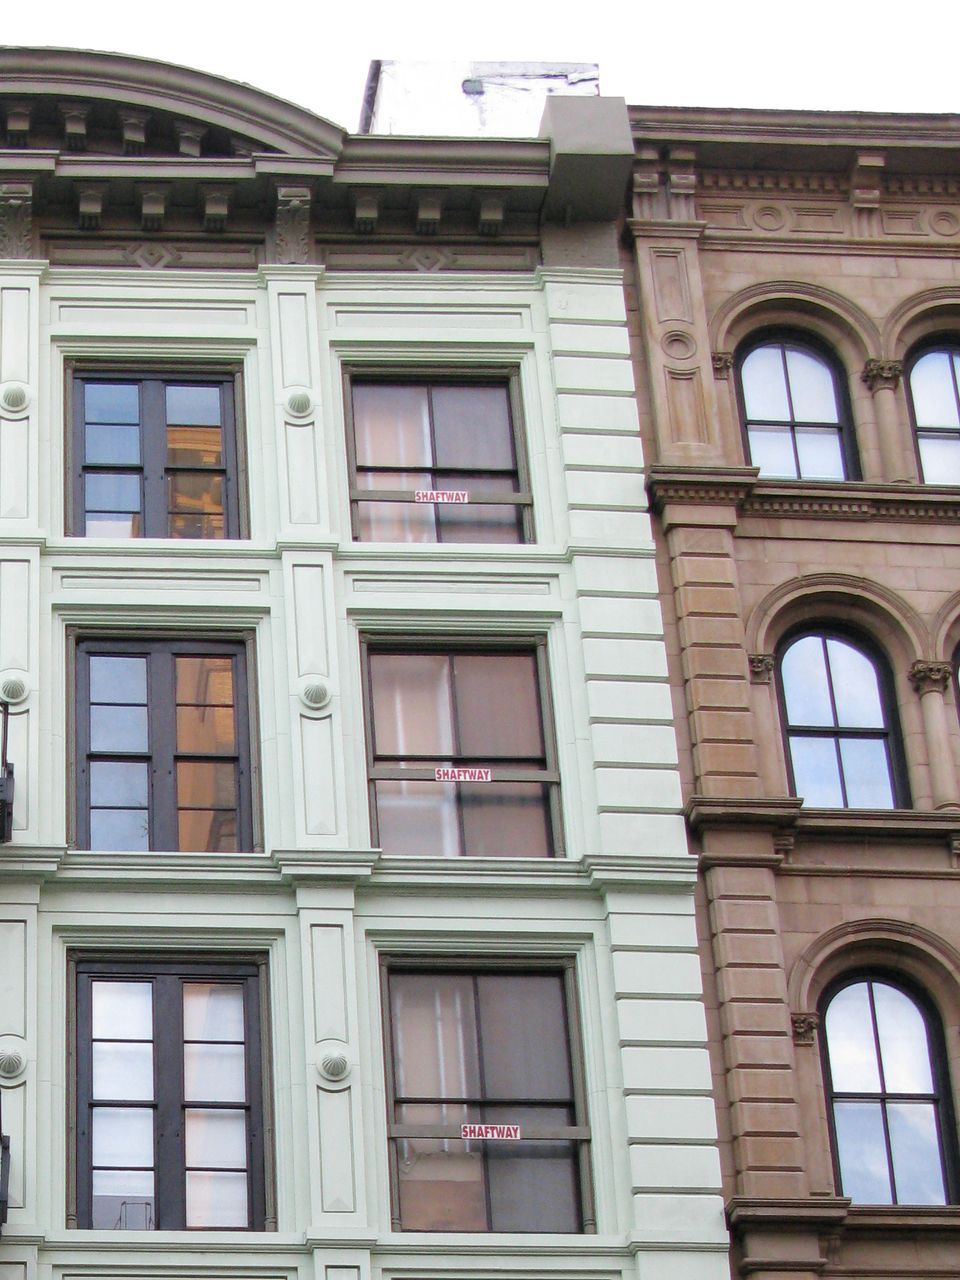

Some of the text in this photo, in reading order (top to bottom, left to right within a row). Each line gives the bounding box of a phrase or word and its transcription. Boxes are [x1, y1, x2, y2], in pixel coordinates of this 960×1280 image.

[415, 491, 467, 502] SHAFTWAY
[436, 768, 490, 781] SHAFTWAY
[462, 1125, 519, 1138] SHAFTWAY
